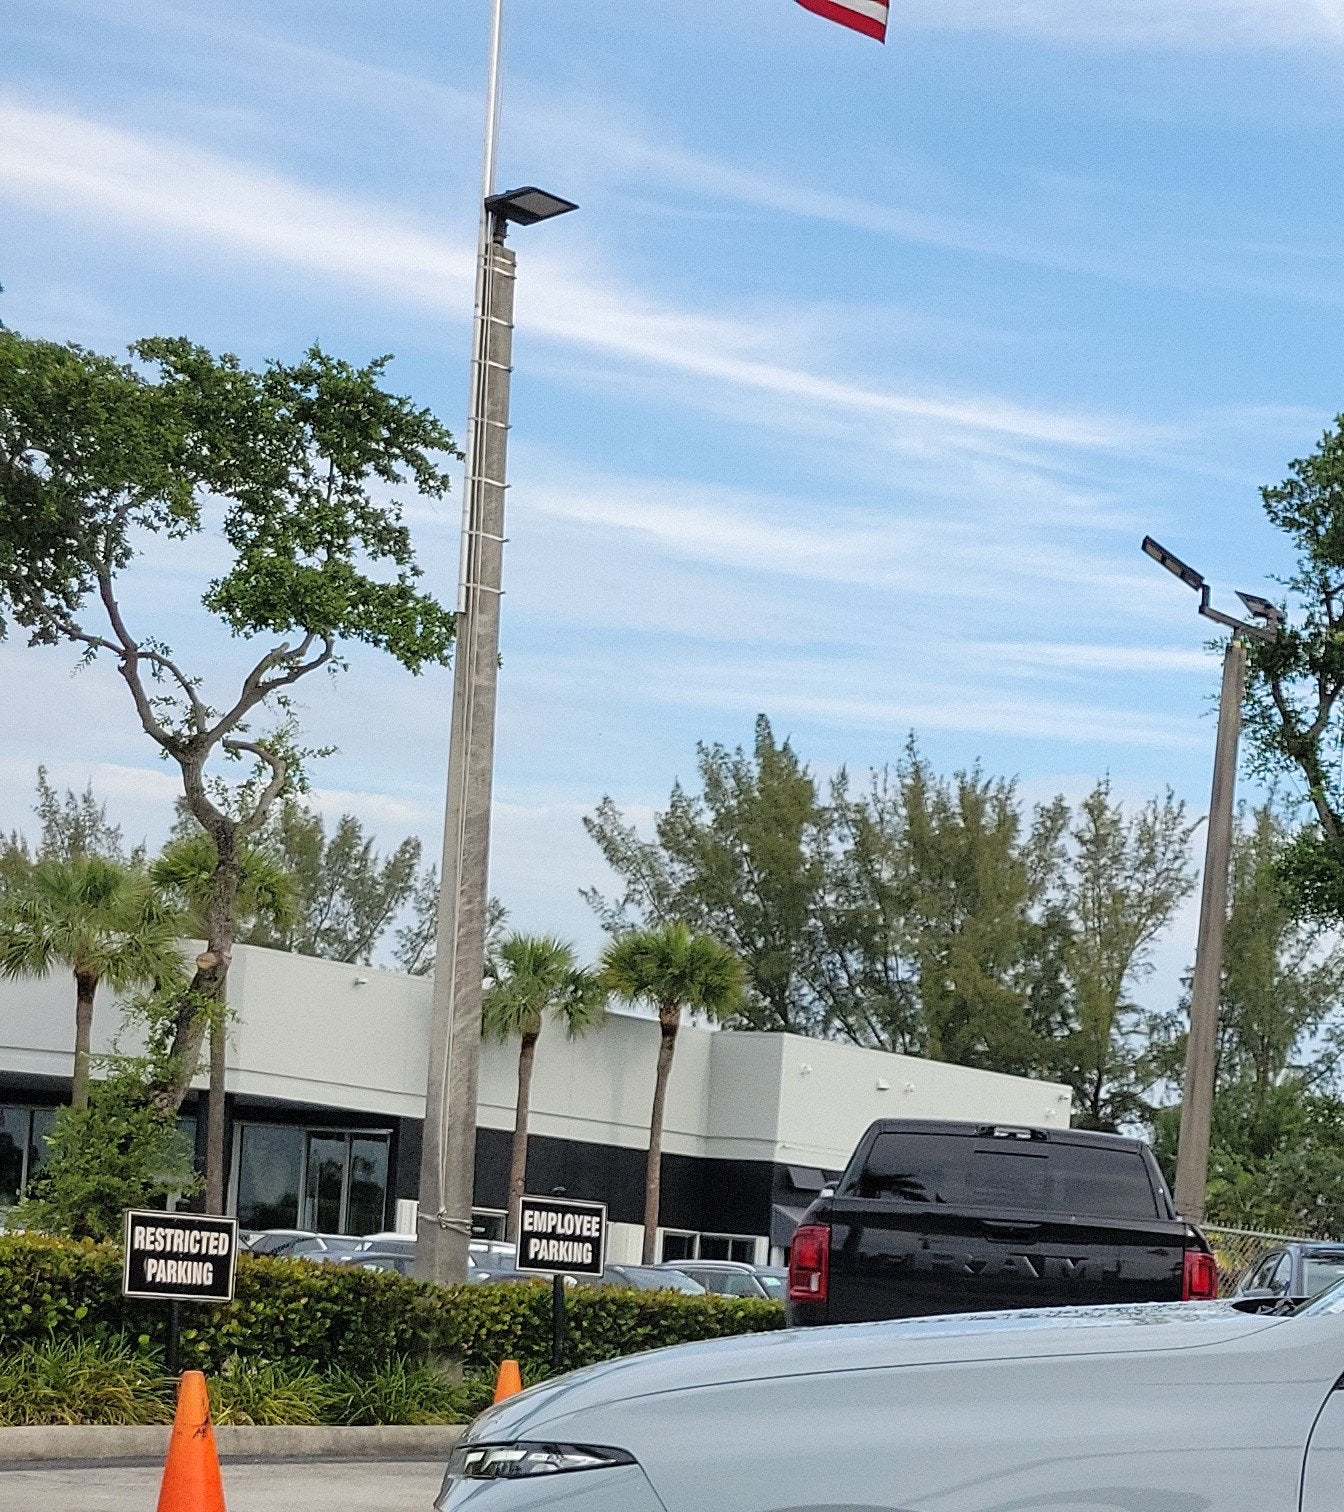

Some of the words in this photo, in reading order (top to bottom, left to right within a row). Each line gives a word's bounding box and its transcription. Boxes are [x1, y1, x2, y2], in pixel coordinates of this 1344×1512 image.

[523, 1209, 600, 1237] EMPLOYEE
[133, 1226, 229, 1256] RESTRICTED
[529, 1238, 592, 1264] PARKING
[146, 1258, 213, 1286] PARKING
